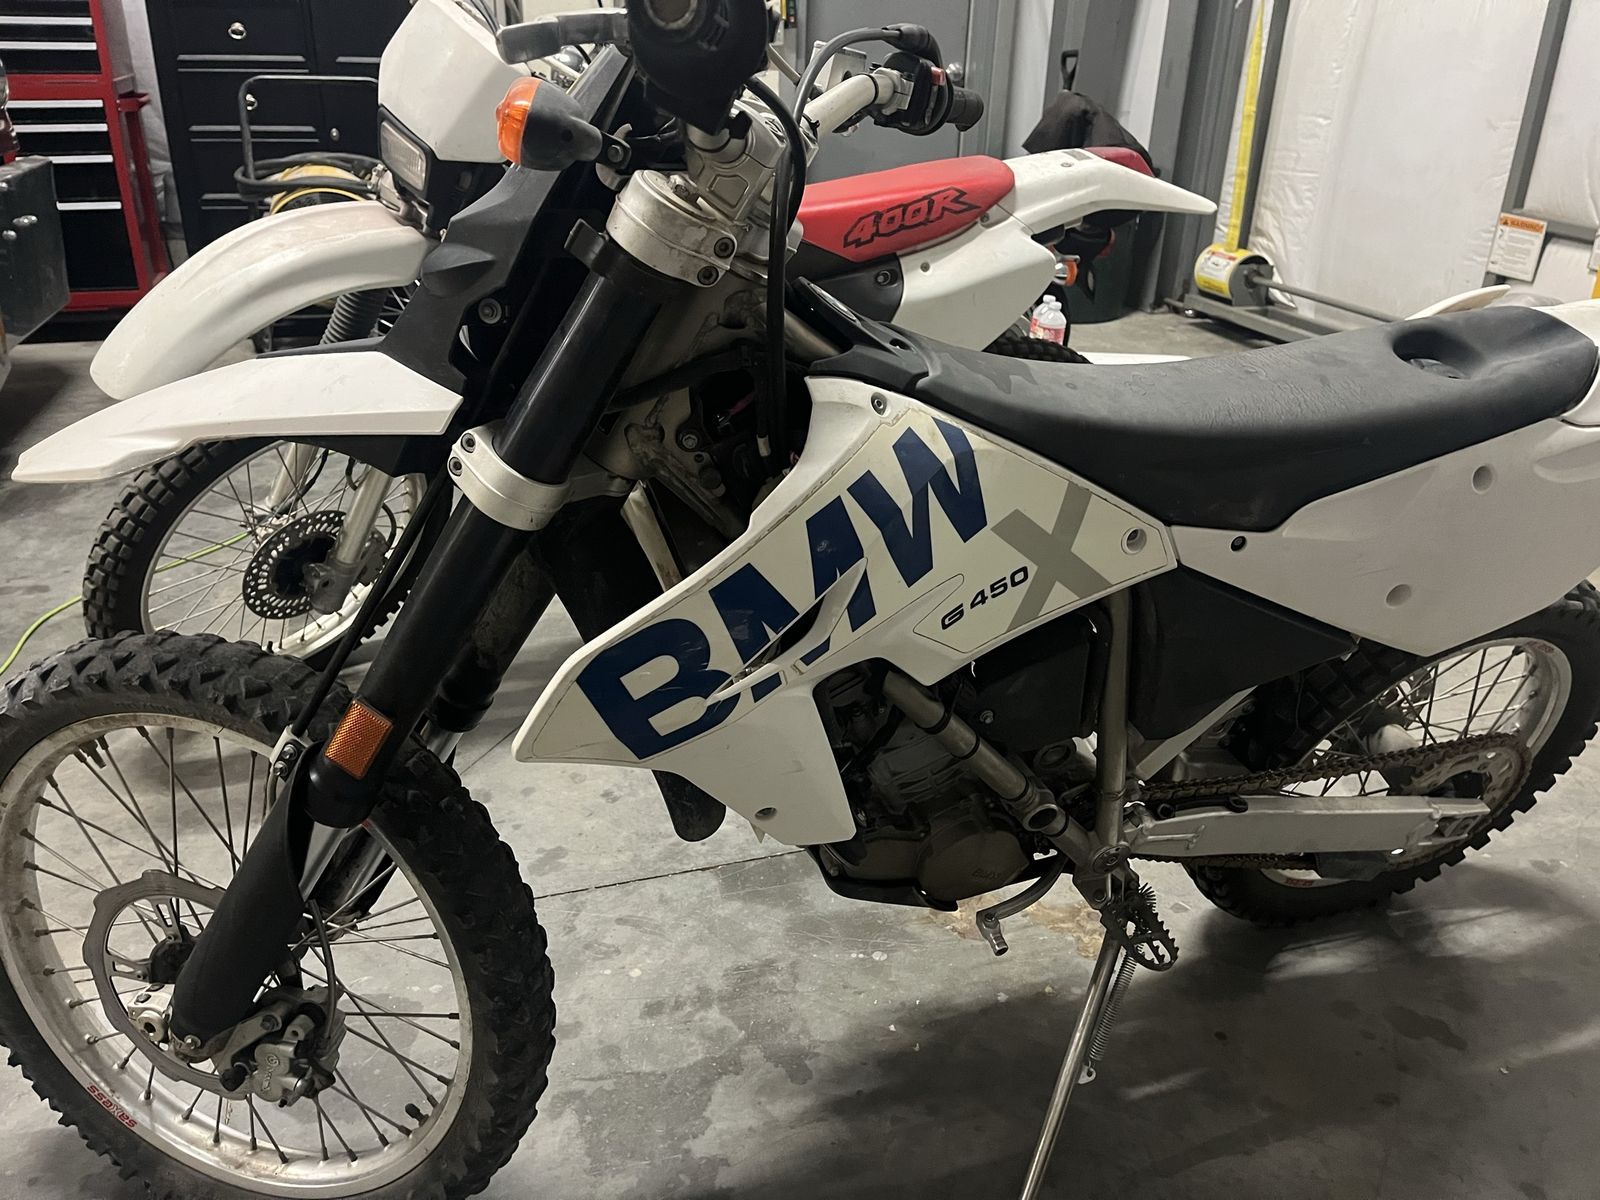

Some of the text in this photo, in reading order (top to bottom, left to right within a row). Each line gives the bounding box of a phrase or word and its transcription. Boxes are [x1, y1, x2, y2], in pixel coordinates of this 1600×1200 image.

[843, 186, 982, 249] 400R
[575, 416, 988, 761] BMW
[941, 480, 1113, 634] G 450 X
[87, 1084, 138, 1129] saxess
